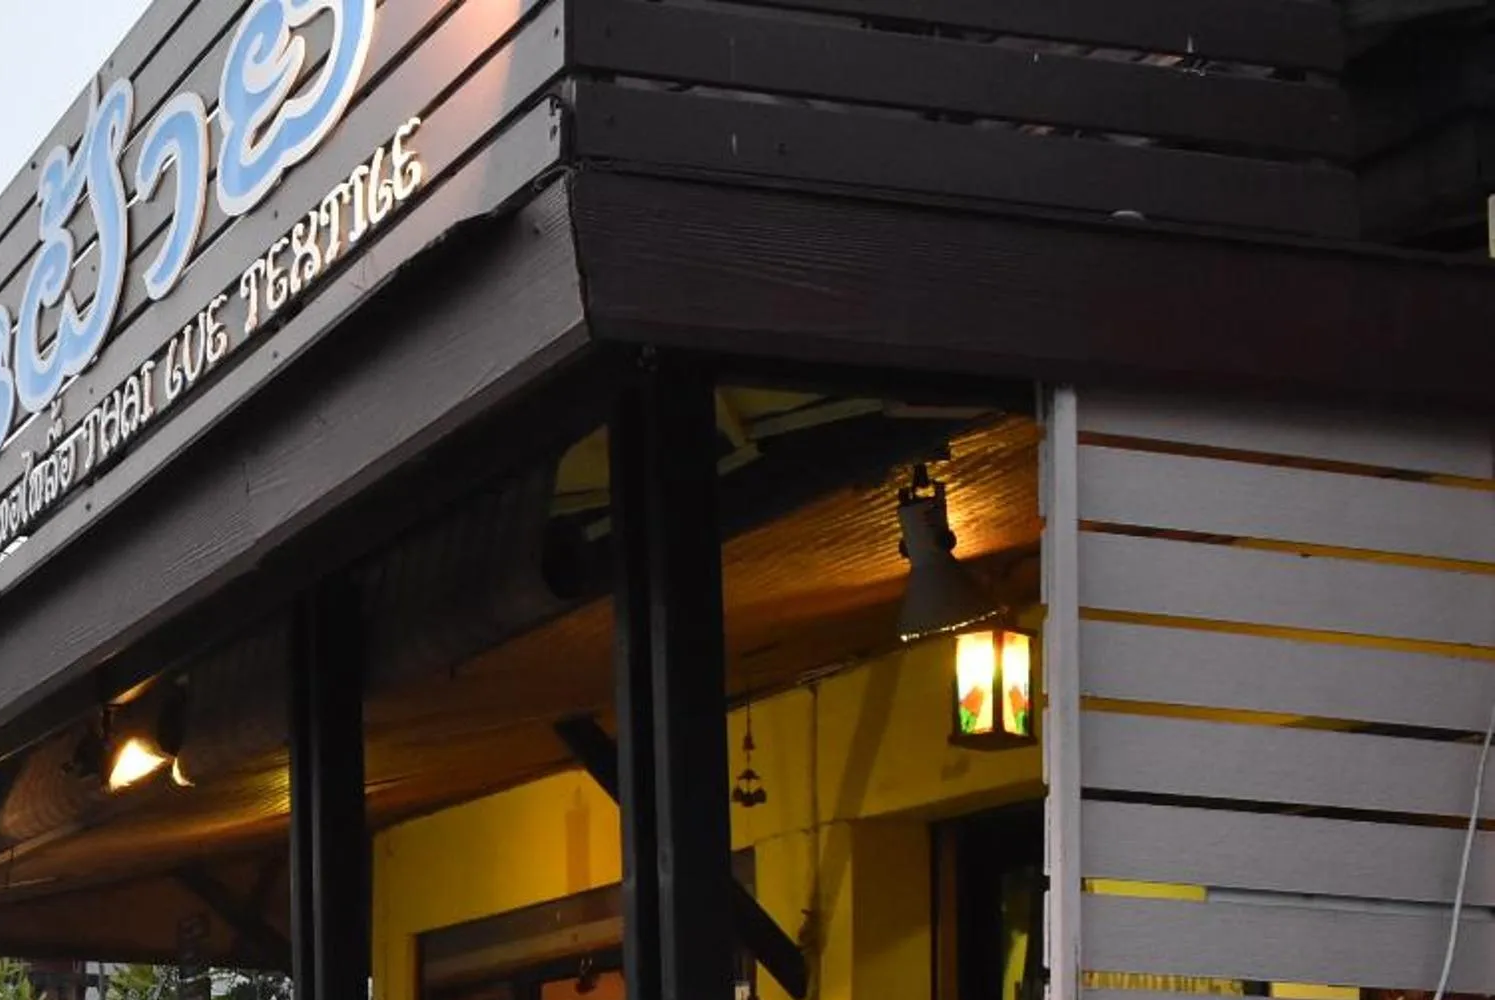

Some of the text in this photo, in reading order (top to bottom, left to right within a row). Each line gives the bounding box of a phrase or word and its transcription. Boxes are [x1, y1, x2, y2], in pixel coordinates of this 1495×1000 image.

[84, 116, 423, 469] THAI LUE TEXTILE
